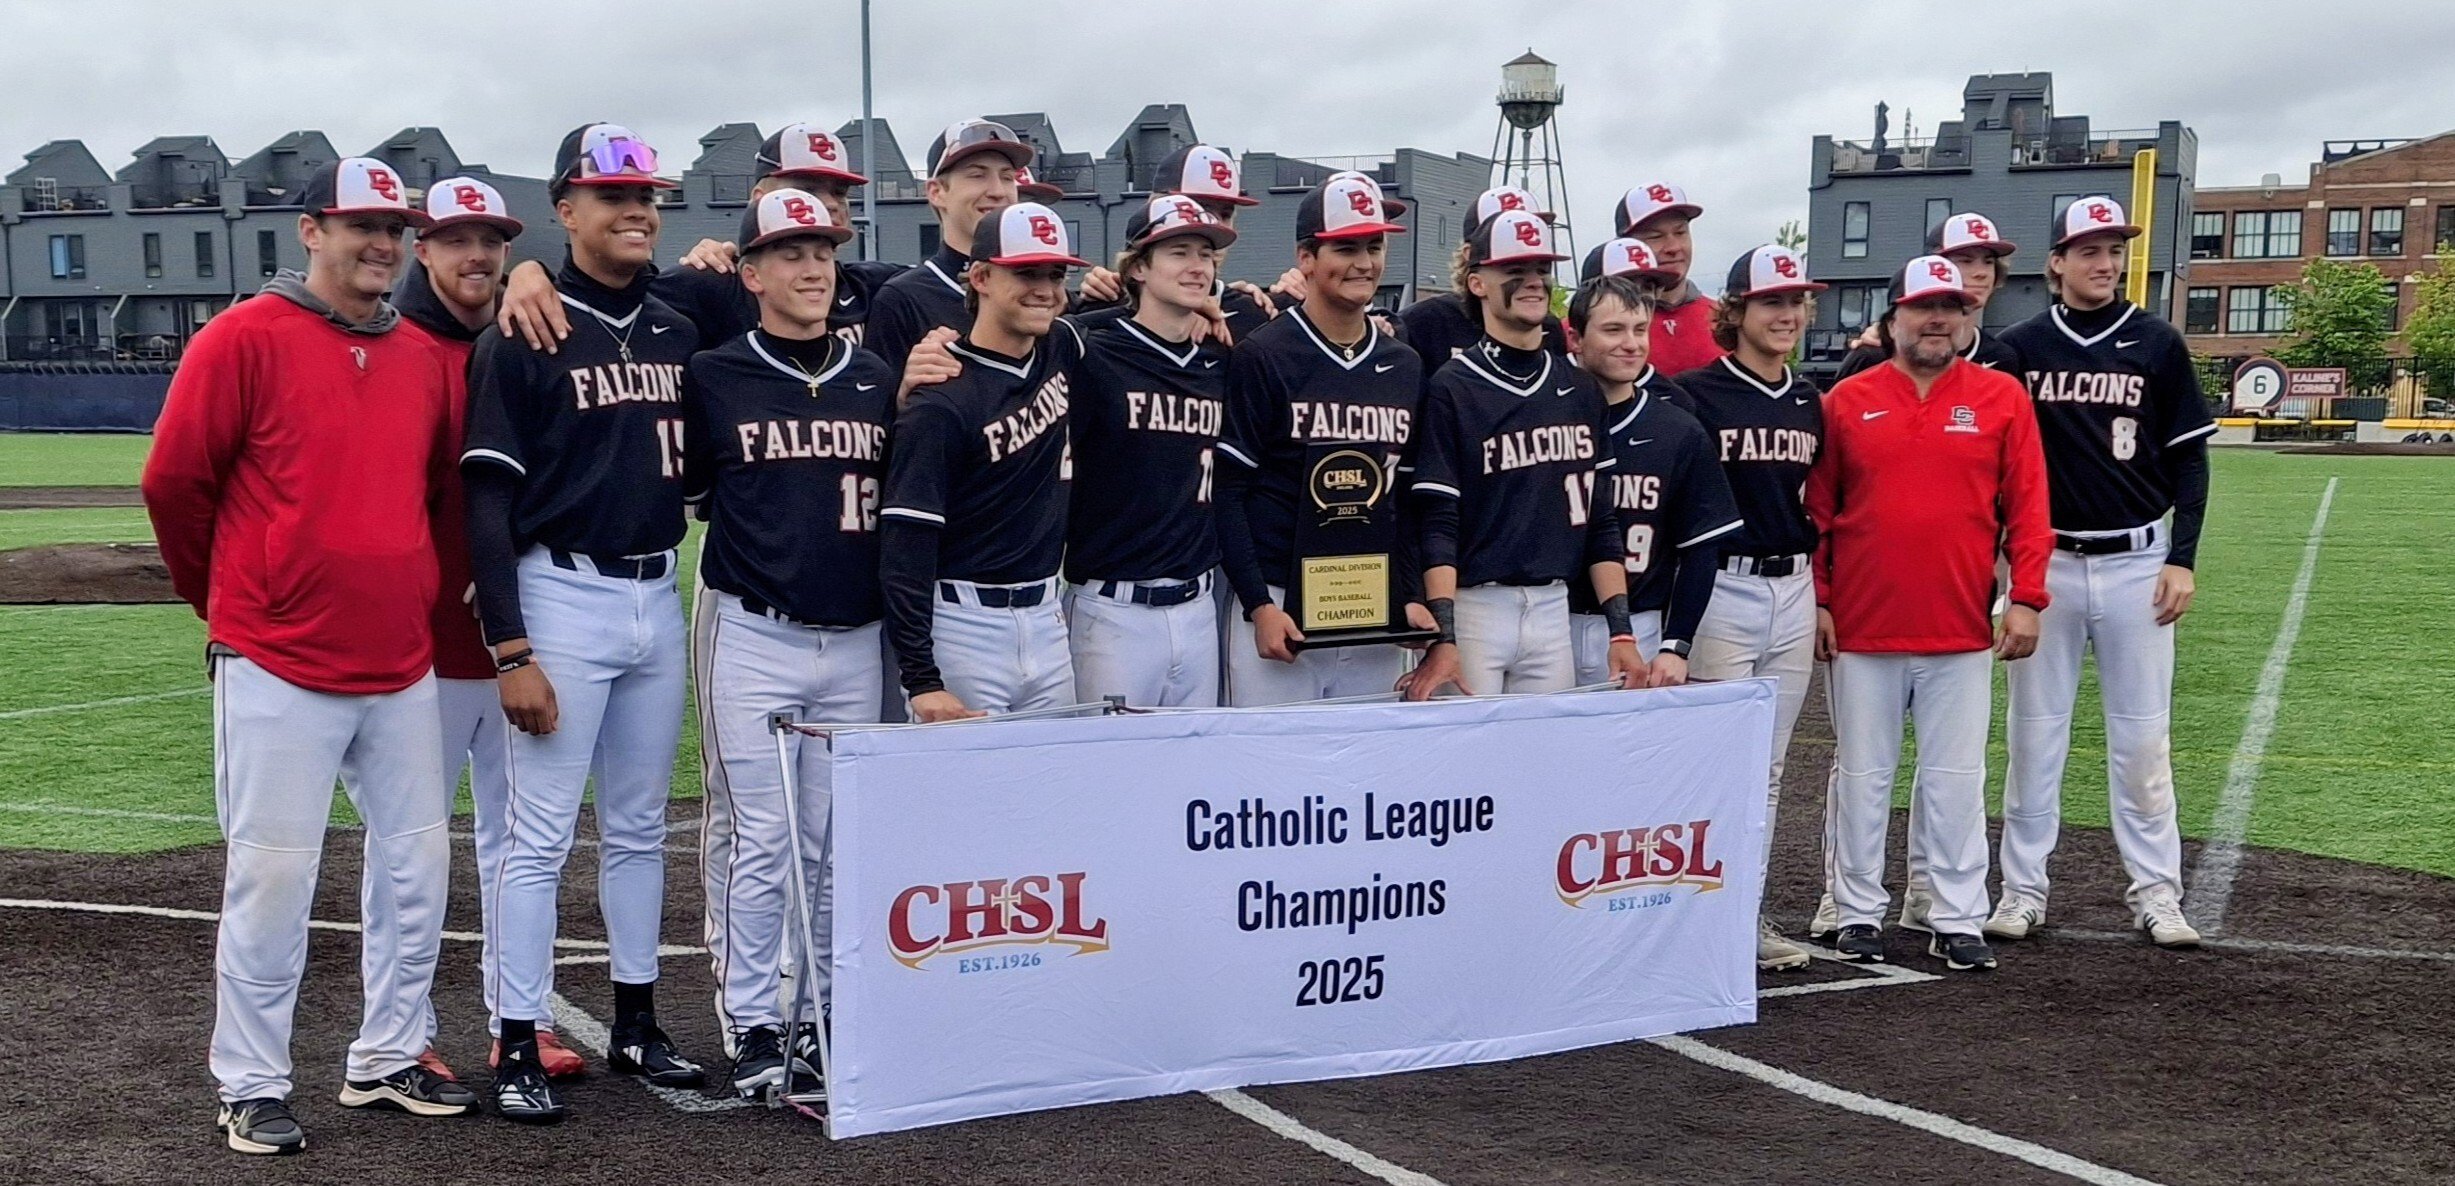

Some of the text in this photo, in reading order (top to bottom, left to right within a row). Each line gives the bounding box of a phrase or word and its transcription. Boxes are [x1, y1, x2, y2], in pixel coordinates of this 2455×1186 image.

[807, 133, 836, 161] DC
[367, 168, 399, 202] DC
[1209, 160, 1233, 189] DC
[453, 185, 487, 212] DC
[1347, 191, 1375, 216] DC
[1646, 184, 1674, 203] DC
[782, 197, 816, 225] DC
[2087, 203, 2114, 223] DC
[1029, 215, 1058, 246] DC
[1514, 221, 1541, 247] DC
[1966, 219, 1990, 240] DC
[1773, 255, 1799, 279] DC
[1928, 261, 1953, 282] DC
[2025, 370, 2145, 407] FALCONS
[2254, 375, 2267, 394] 6
[2291, 384, 2336, 394] CORNER
[2292, 373, 2341, 383] KALINE'S
[1126, 391, 1223, 437] FALCON
[1290, 402, 1411, 445] FALCONS
[737, 420, 887, 463] FALCONS
[1482, 425, 1595, 475] FALCONS
[2111, 416, 2139, 461] 8
[1323, 469, 1367, 486] CHSL
[839, 472, 880, 532] 12
[1337, 506, 1359, 516] 2025
[1624, 523, 1654, 573] 9
[1309, 562, 1383, 574] CARDINAL DIVISION
[1338, 591, 1373, 602] BASEBALL
[1317, 608, 1375, 621] CHAMPION
[1186, 792, 1494, 851] Catholic League
[1557, 819, 1723, 894] CHSL
[889, 871, 1106, 953] CHSL
[1238, 873, 1446, 935] Champions
[1296, 954, 1385, 1007] 2025
